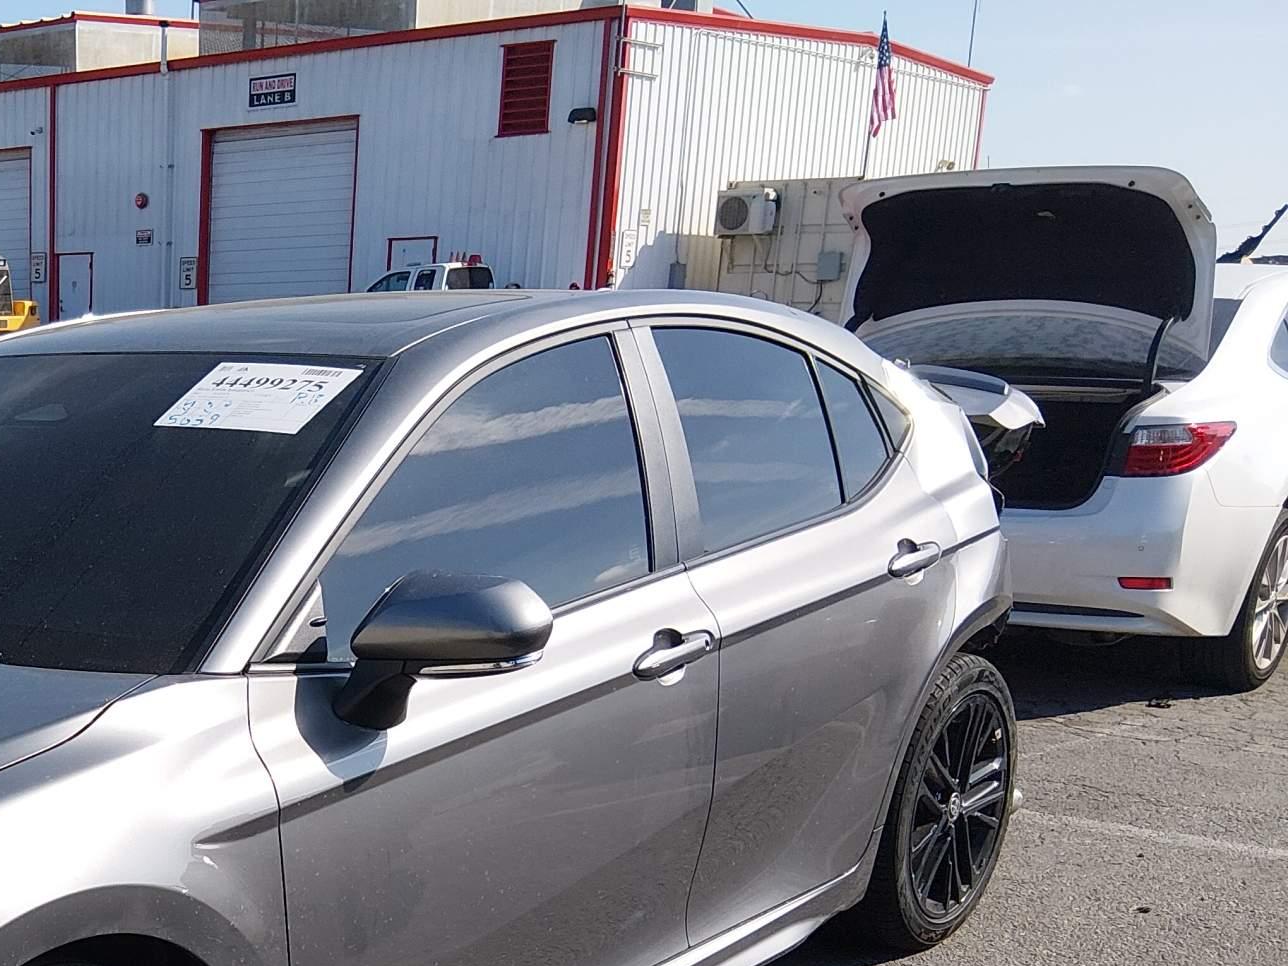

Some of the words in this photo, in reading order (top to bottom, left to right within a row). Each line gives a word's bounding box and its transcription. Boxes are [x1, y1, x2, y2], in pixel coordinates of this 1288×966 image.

[253, 92, 281, 105] LANE
[284, 92, 291, 102] B
[625, 250, 631, 263] 5
[34, 268, 41, 279] 5
[185, 274, 192, 286] 5
[212, 376, 328, 392] 44499275
